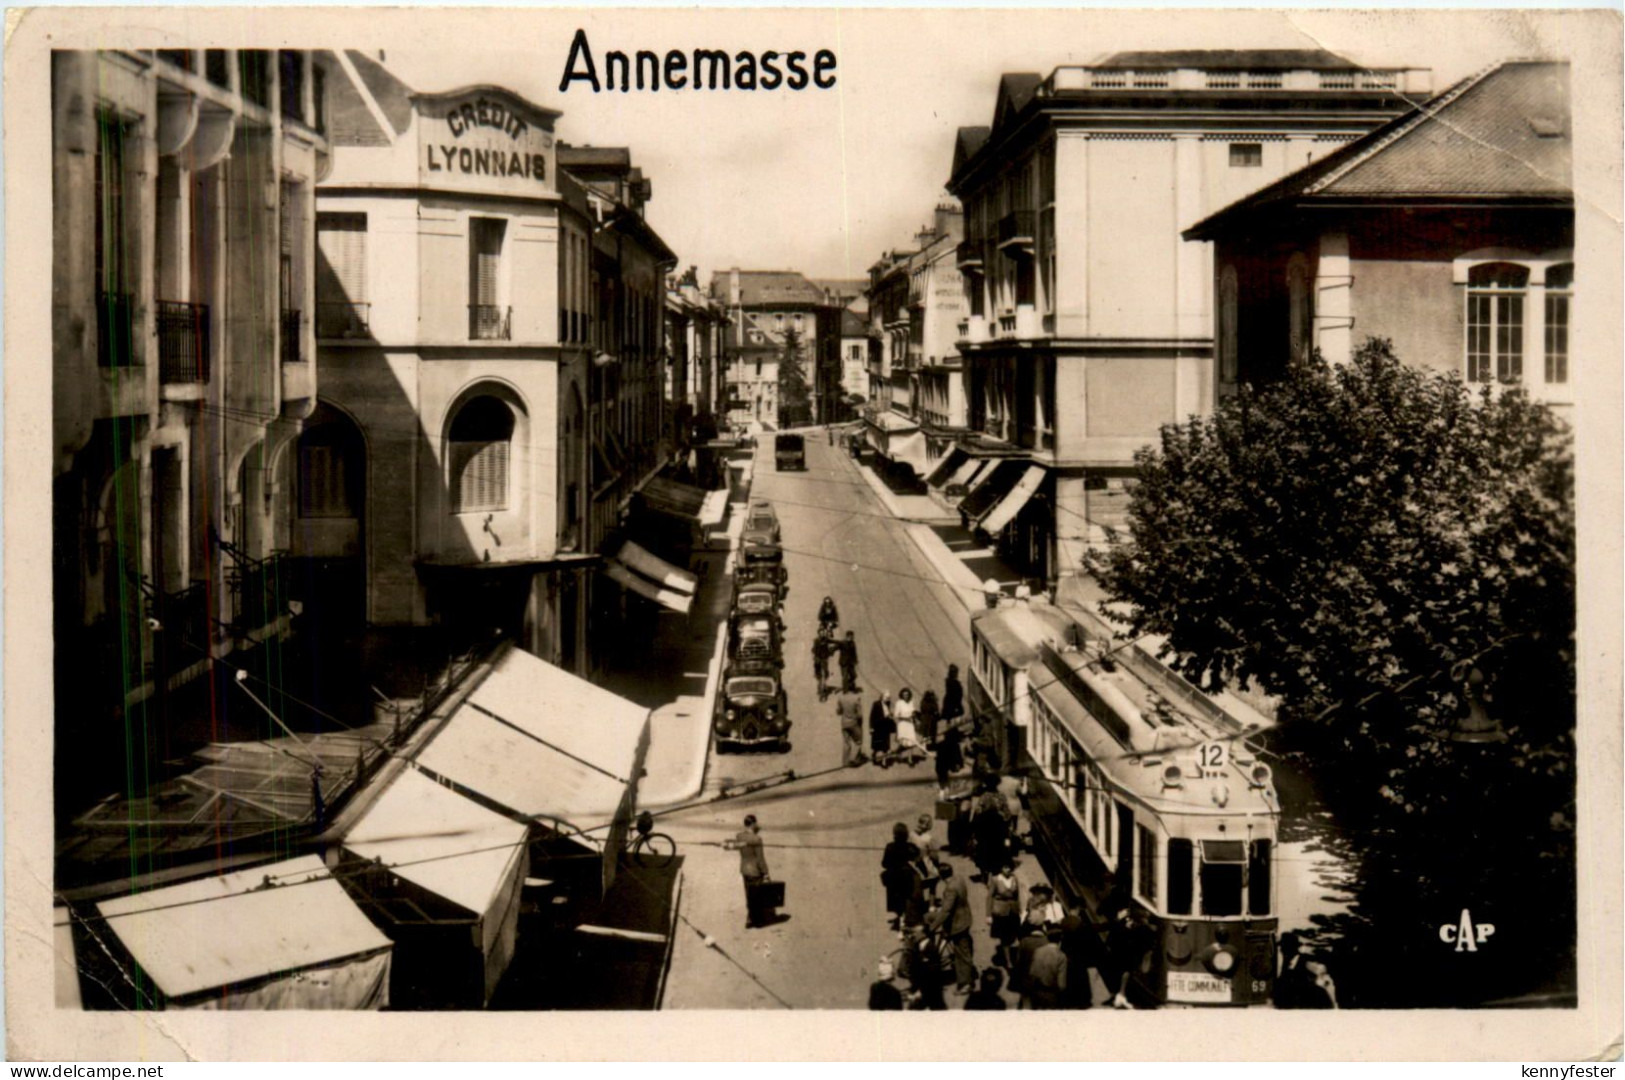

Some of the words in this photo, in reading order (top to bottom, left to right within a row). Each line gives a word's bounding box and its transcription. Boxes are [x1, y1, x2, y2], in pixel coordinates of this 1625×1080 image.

[447, 98, 528, 140] CRÉDIT
[427, 144, 546, 181] LYONNAIS
[1200, 744, 1223, 767] 12
[1252, 980, 1266, 993] 69
